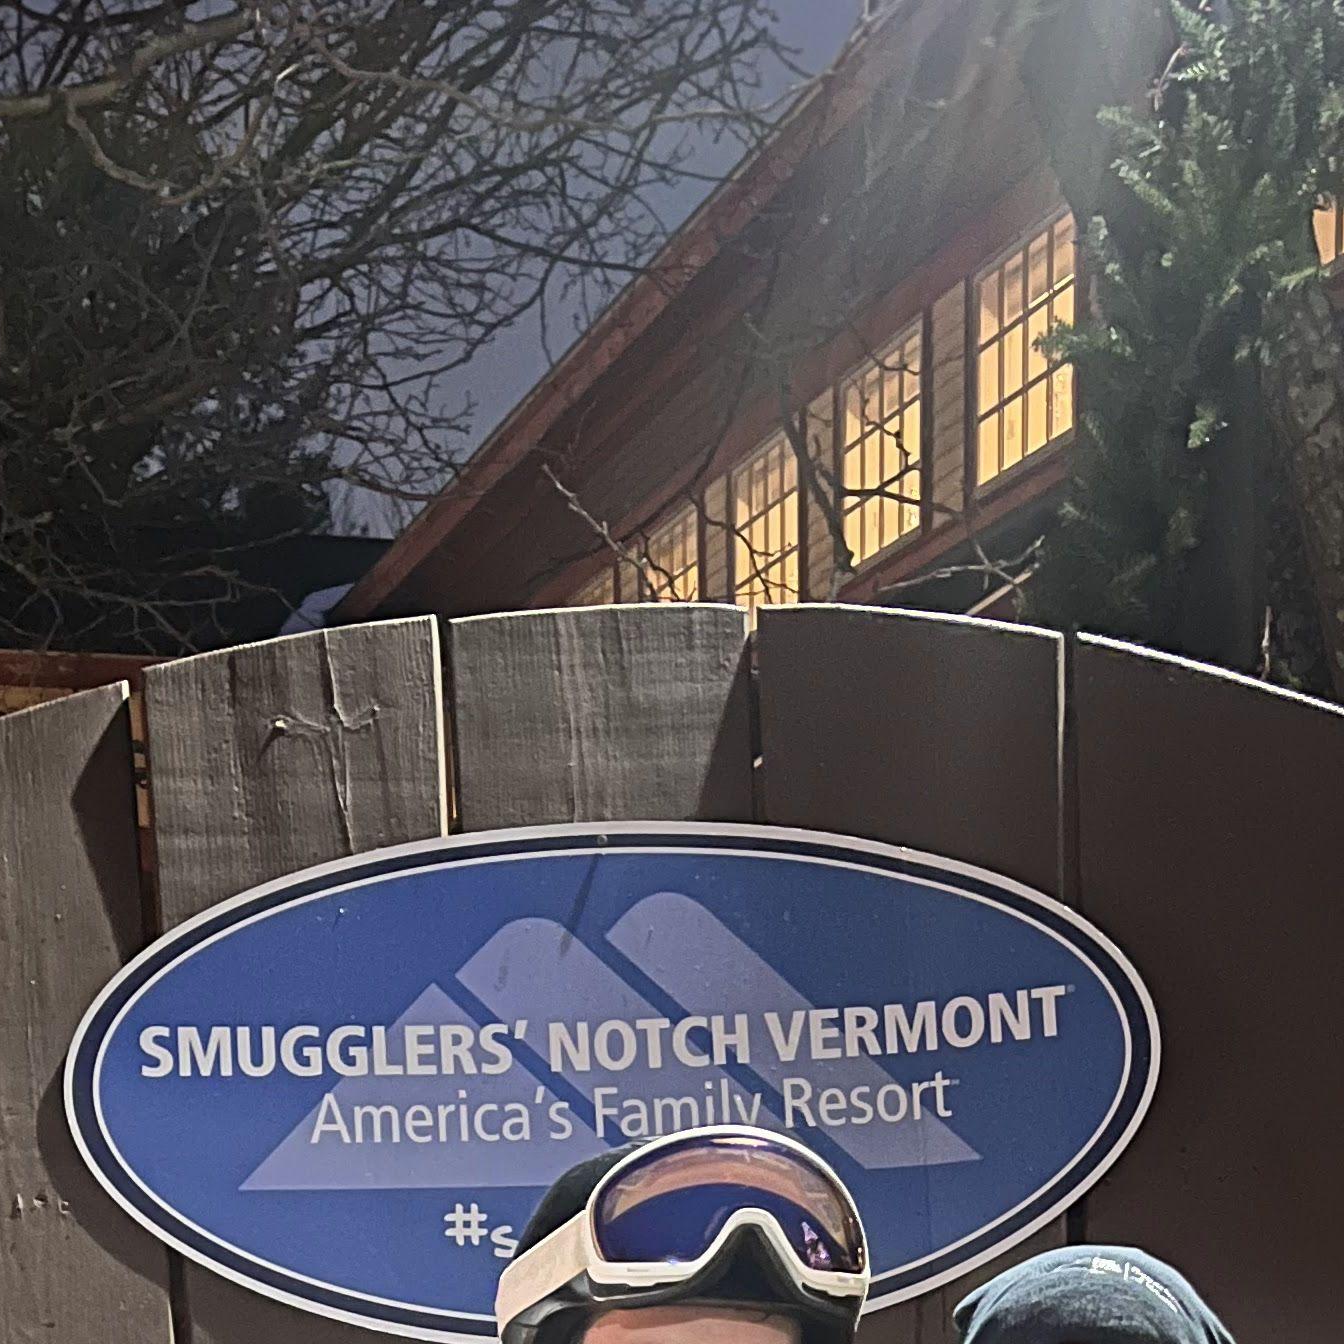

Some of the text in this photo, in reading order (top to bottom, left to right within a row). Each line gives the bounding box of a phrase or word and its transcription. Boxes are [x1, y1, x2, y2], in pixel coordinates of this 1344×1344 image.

[138, 985, 1066, 1078] SMUGGLERS' NOTCH VERMONT
[311, 1070, 953, 1144] America's Family Resort
[443, 1202, 520, 1258] #s
